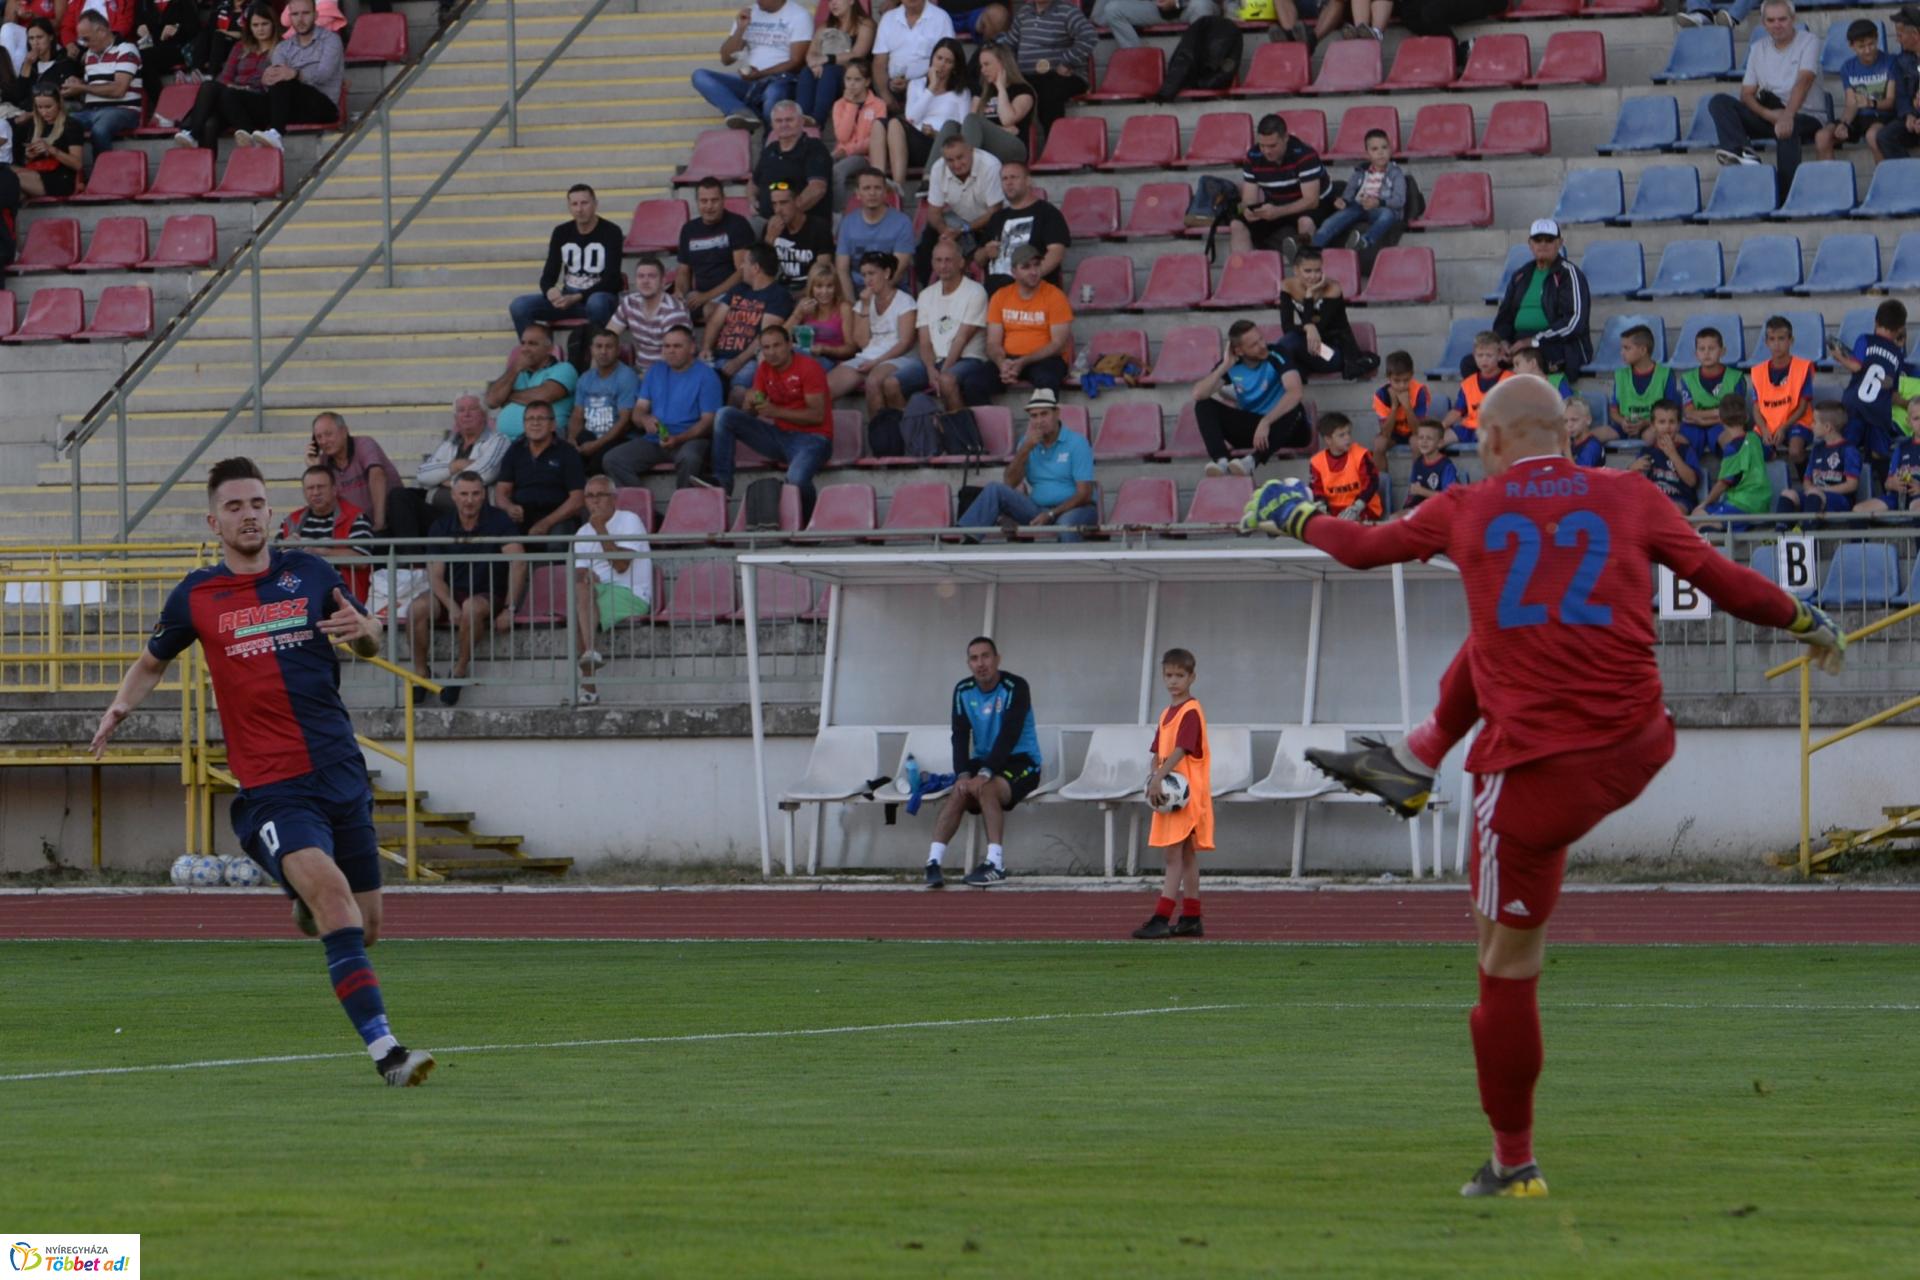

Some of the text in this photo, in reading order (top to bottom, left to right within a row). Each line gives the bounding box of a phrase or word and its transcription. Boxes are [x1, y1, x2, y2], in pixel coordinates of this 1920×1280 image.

[561, 242, 606, 273] 00
[1857, 363, 1886, 403] 6
[1506, 473, 1589, 497] RADOŠ
[1484, 510, 1614, 630] 22
[1786, 542, 1808, 587] B
[1672, 573, 1699, 611] B
